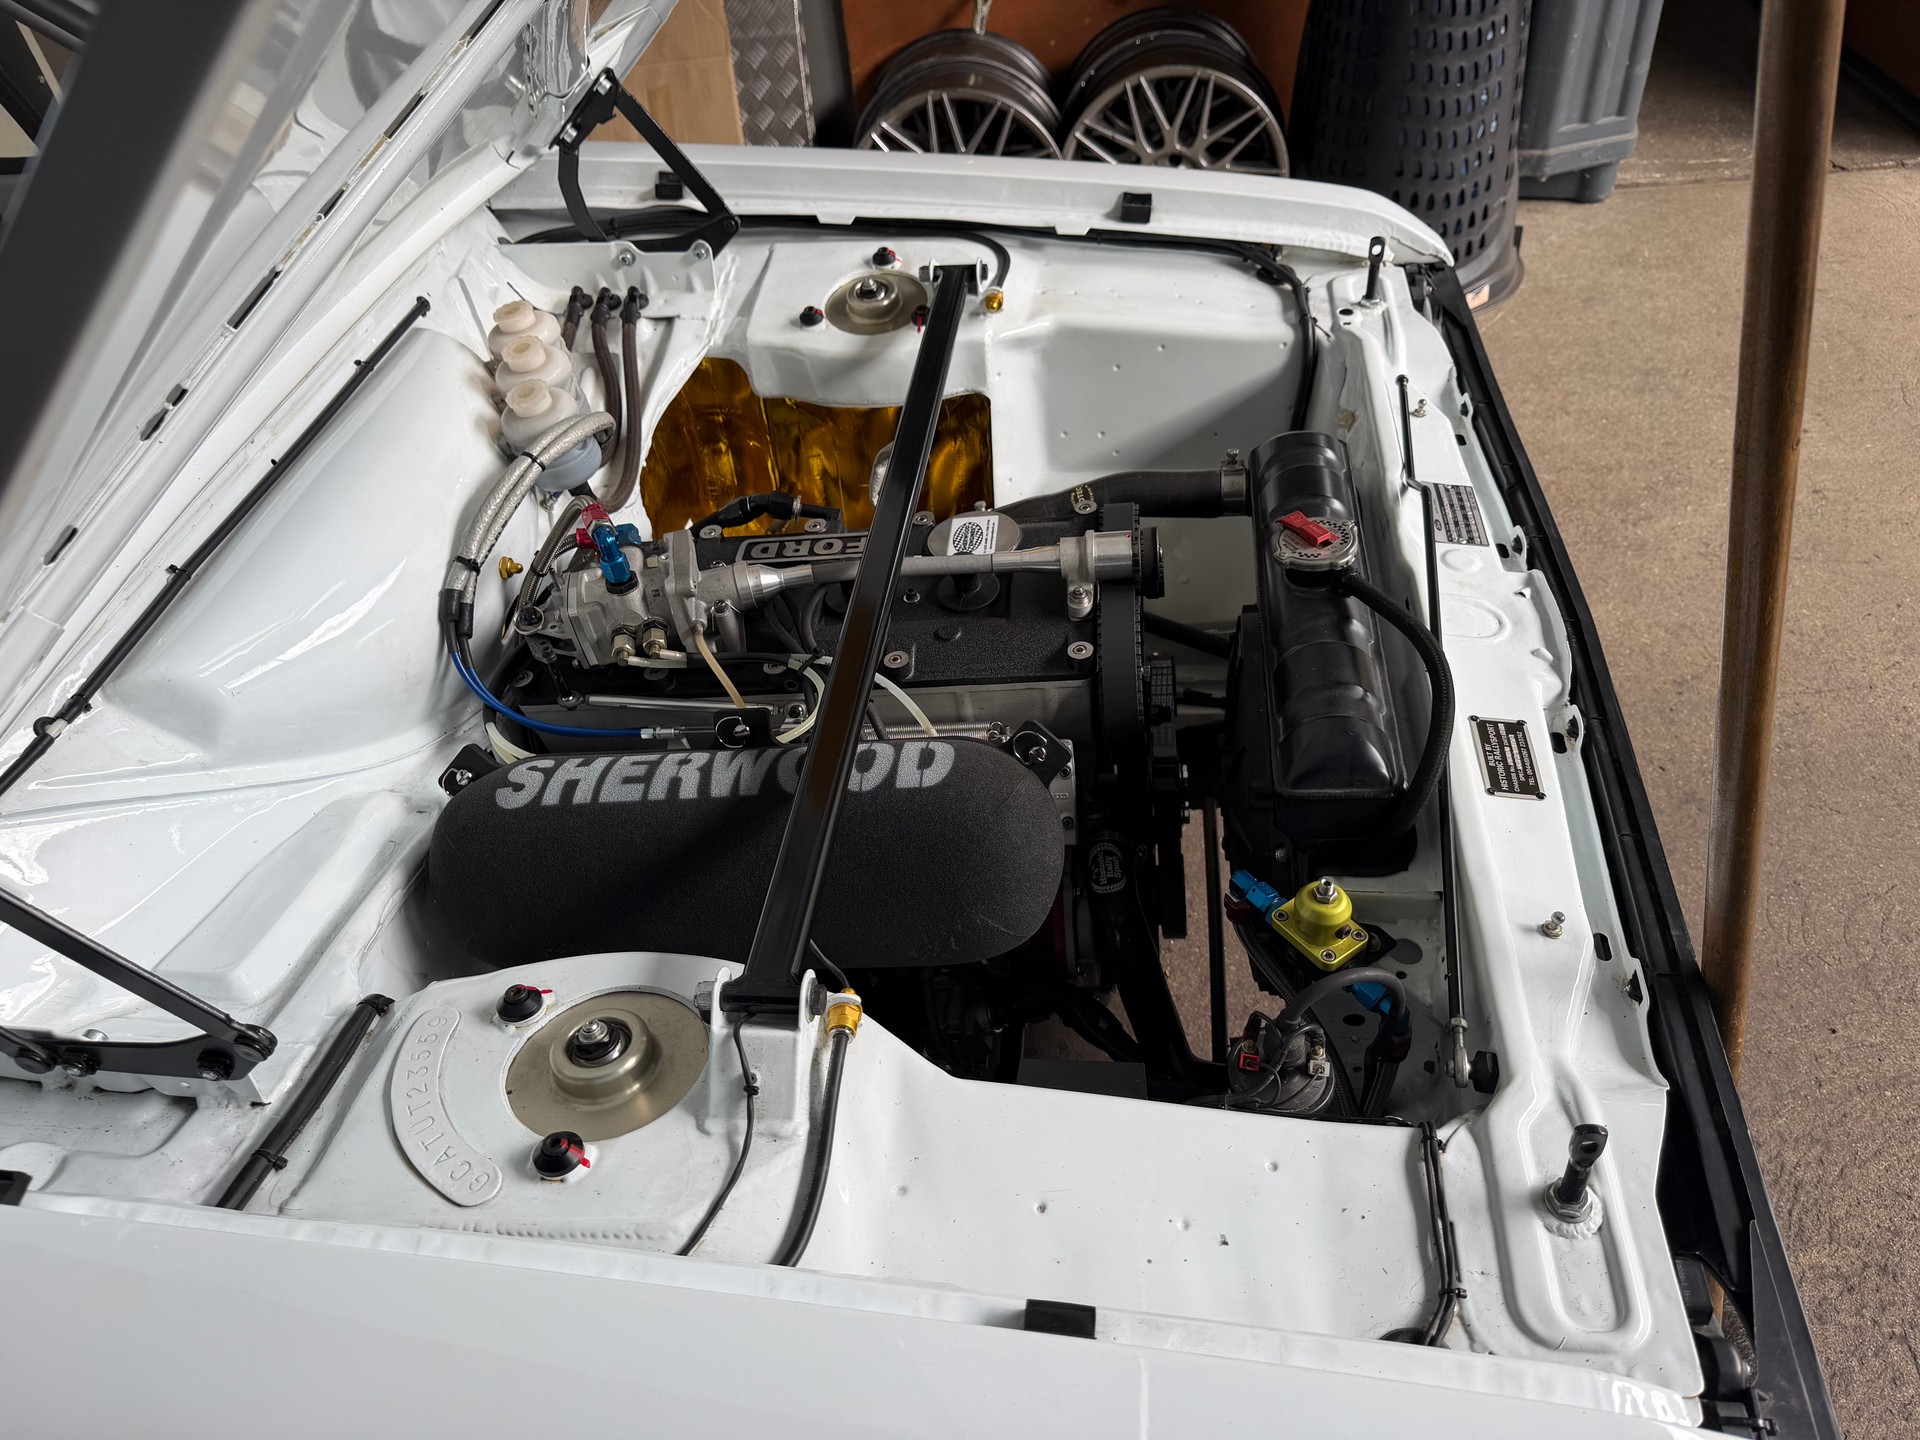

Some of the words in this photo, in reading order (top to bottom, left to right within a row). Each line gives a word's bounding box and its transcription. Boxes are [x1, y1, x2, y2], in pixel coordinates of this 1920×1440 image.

[751, 537, 868, 559] FORD
[1484, 743, 1492, 751] BY
[1486, 723, 1502, 760] RALLYSPORT
[1486, 752, 1496, 767] BUILT
[1496, 761, 1509, 791] HISTORIC
[1097, 851, 1107, 884] Historic
[1105, 856, 1114, 877] Rally
[1113, 856, 1122, 879] Sport
